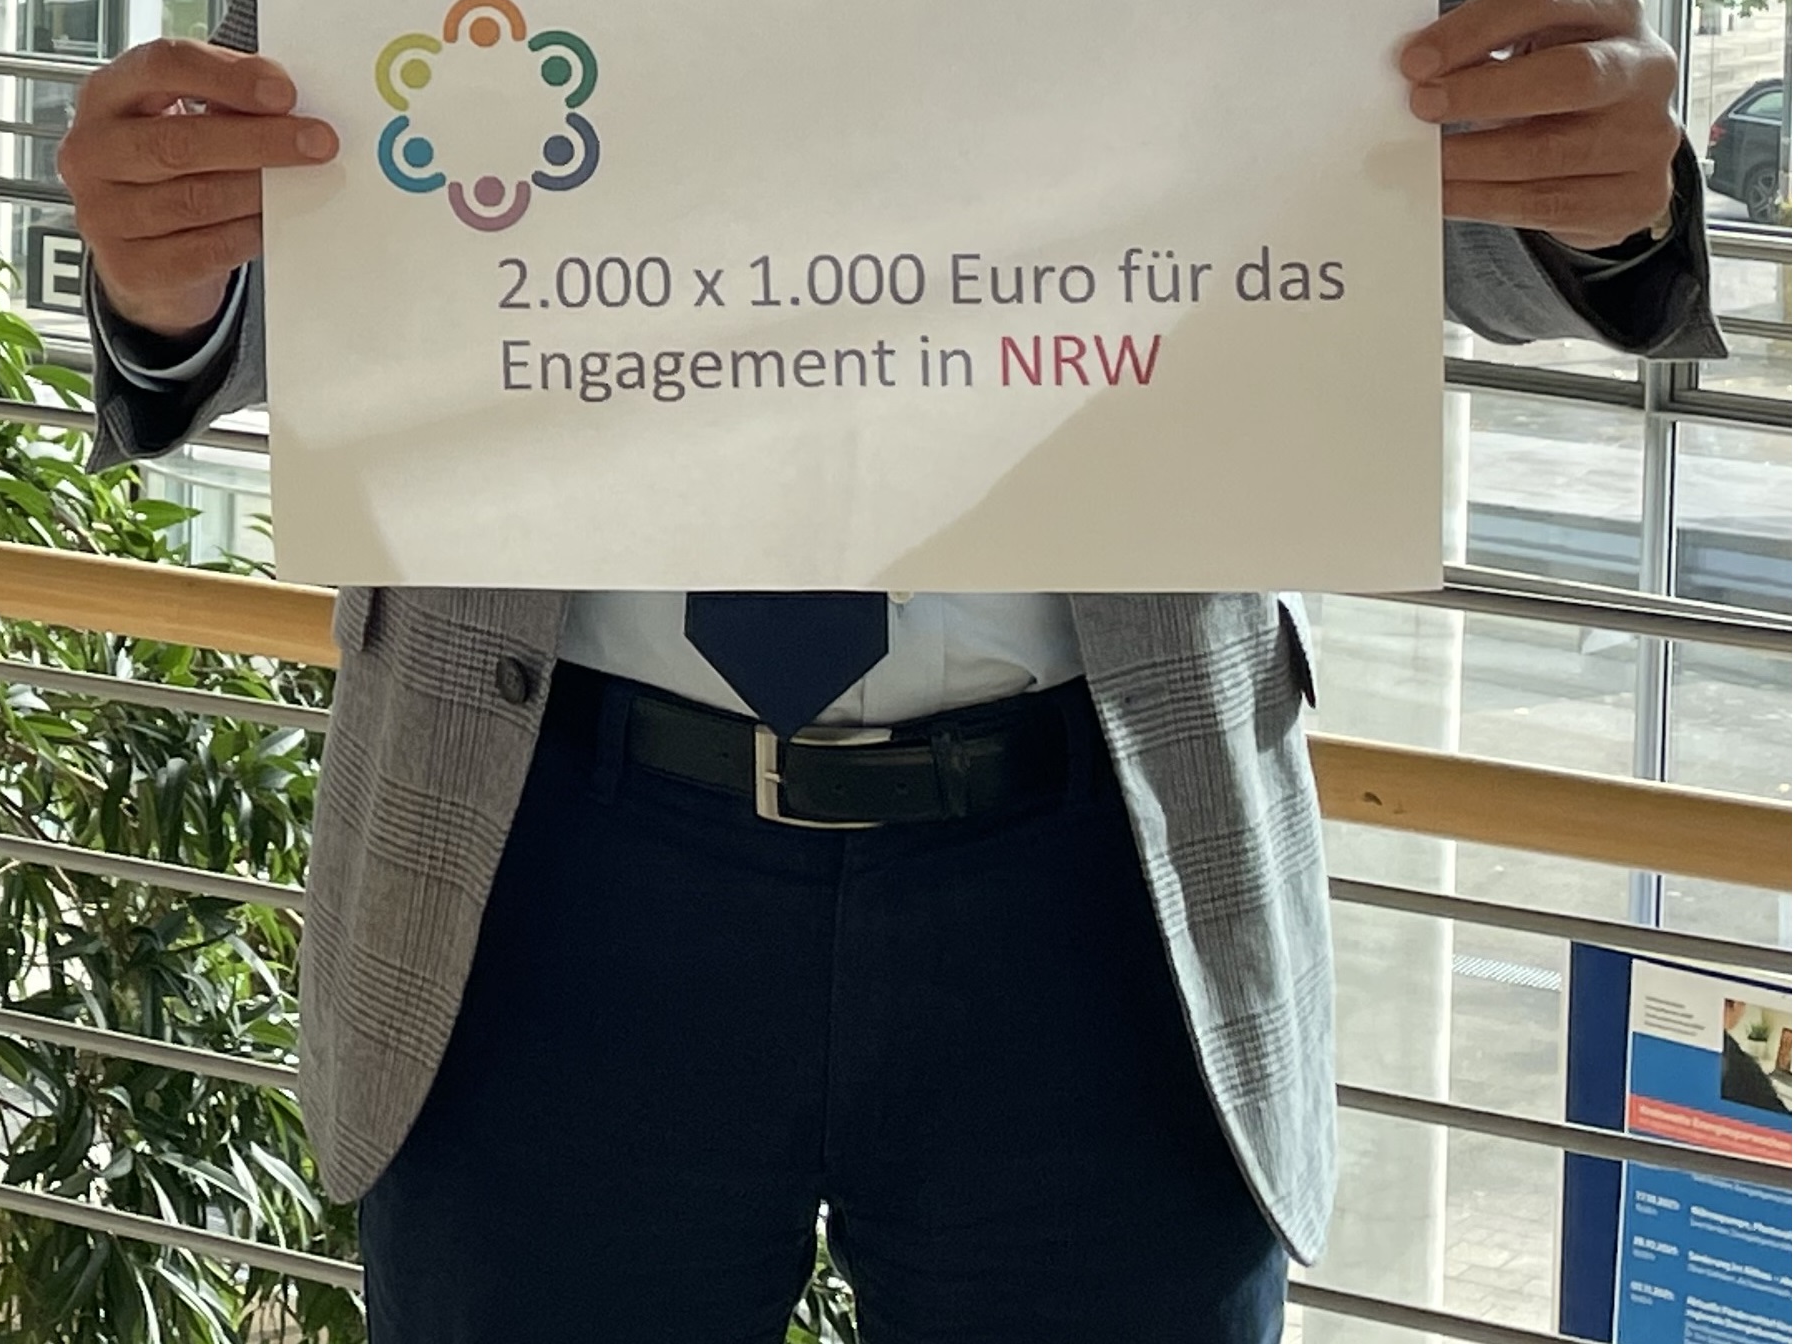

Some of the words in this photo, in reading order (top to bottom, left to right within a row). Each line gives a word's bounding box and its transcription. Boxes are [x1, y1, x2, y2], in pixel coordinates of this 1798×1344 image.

[497, 256, 672, 310] 2.000
[692, 268, 726, 308] x
[749, 253, 927, 307] 1.000
[951, 253, 1096, 306] Euro
[1117, 247, 1214, 304] für
[1235, 244, 1345, 302] das
[502, 339, 897, 404] Engagement
[919, 334, 974, 388] in
[1000, 333, 1163, 387] NRW
